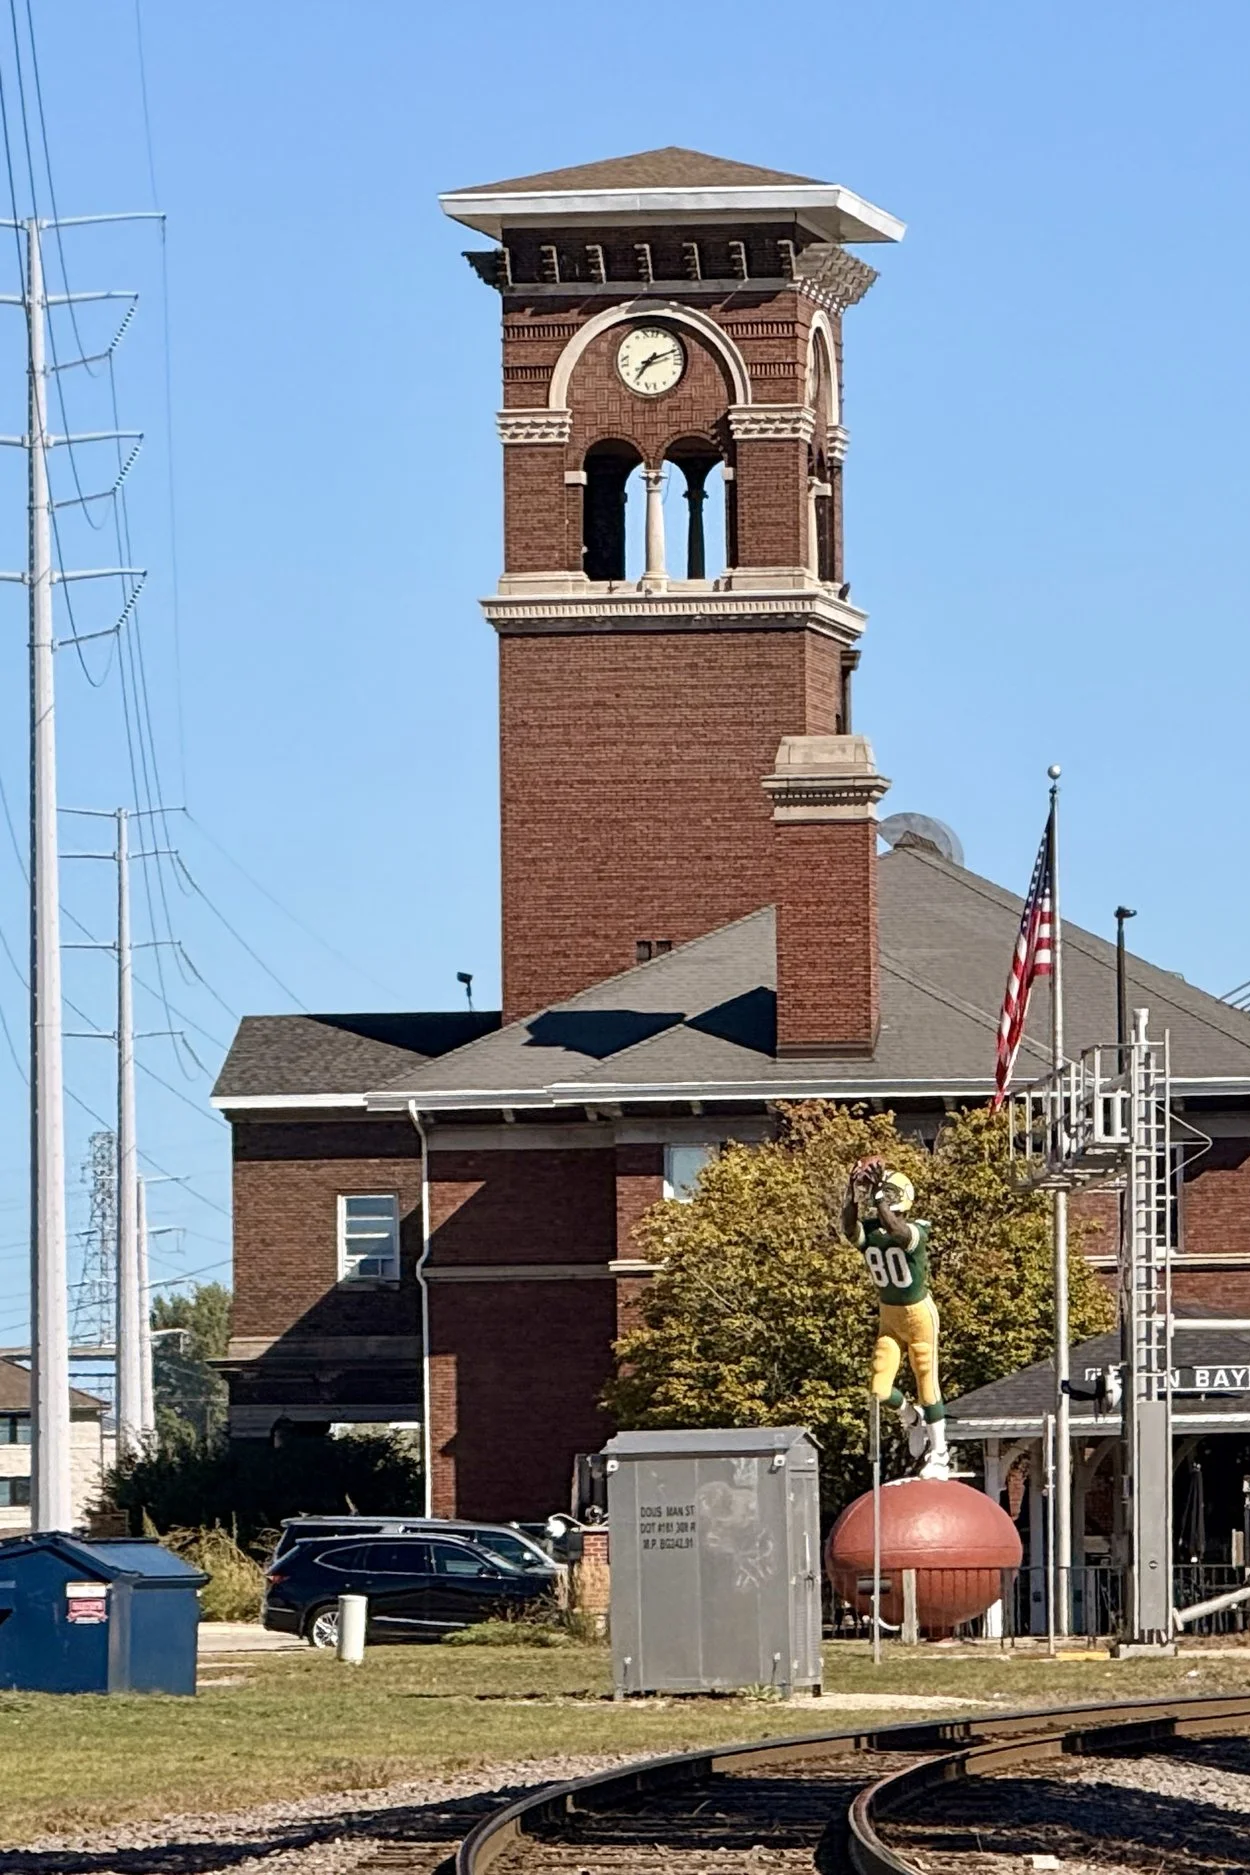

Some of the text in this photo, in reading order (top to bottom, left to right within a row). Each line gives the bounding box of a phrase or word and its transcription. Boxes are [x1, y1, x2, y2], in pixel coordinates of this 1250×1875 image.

[865, 1246, 913, 1288] 80
[1195, 1369, 1247, 1388] BAY
[640, 1523, 656, 1534] DOT
